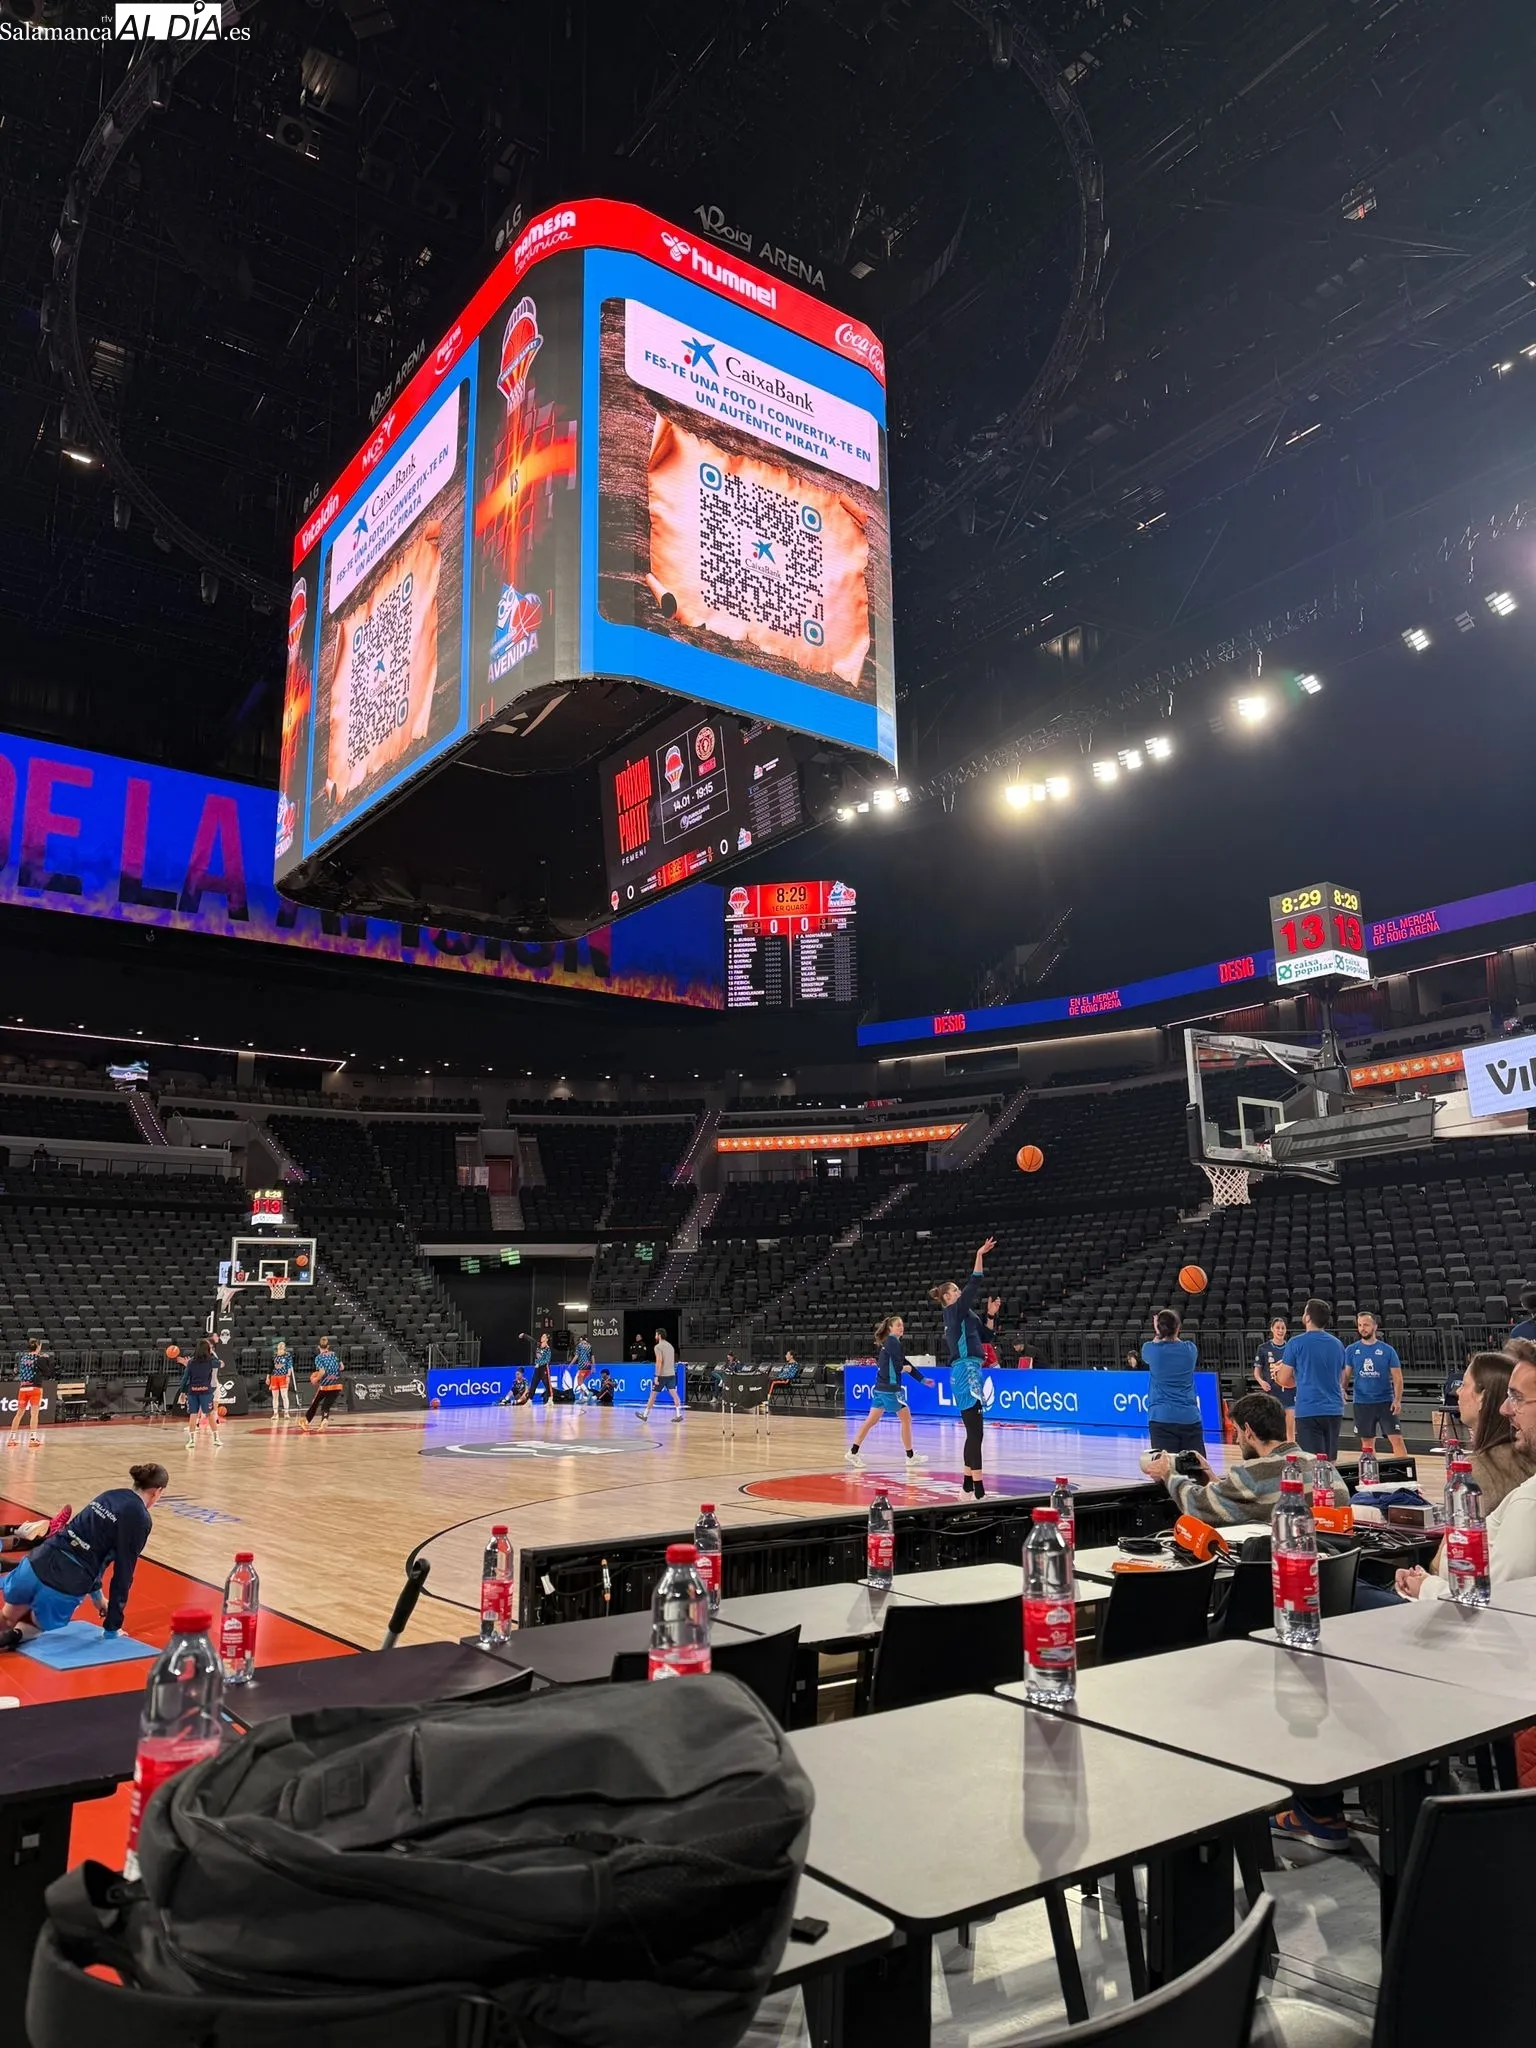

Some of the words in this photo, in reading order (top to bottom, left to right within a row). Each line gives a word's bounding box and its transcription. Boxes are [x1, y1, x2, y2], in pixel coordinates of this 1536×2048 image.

[505, 203, 522, 238] LG
[514, 210, 576, 266] PAMESA
[692, 247, 776, 310] hummel
[759, 242, 826, 291] ARENA
[394, 338, 426, 392] ARENA
[725, 356, 814, 413] CaixaBank
[644, 350, 687, 379] FES-TE
[690, 371, 720, 394] UNA
[723, 387, 756, 410] FOTO
[760, 403, 764, 414] I
[767, 407, 853, 455] CONVERTIX-TE
[855, 447, 871, 463] EN
[695, 390, 716, 409] UN
[719, 403, 782, 439] AUTÈNTIC
[785, 432, 829, 459] PIRATA
[361, 433, 385, 472] MGS
[371, 453, 416, 517] CaixaBank
[336, 559, 354, 585] FES-TE
[354, 542, 368, 564] UNA
[368, 521, 385, 546] FOTO
[389, 459, 438, 521] CONVERTIX-TE
[438, 444, 449, 465] EN
[355, 560, 365, 577] UN
[397, 494, 422, 529] PIRATA
[744, 558, 781, 579] CaixaBank
[487, 632, 539, 684] AVENIDA
[696, 781, 714, 803] 19:15
[0, 755, 94, 896] E
[118, 776, 250, 922] LA
[618, 799, 650, 855] PARTIT
[719, 839, 729, 855] 0
[627, 885, 635, 900] 0
[776, 886, 807, 903] 8:29
[1281, 889, 1322, 914] 8:29
[1333, 889, 1359, 911] 8:29
[785, 904, 808, 912] QUART
[770, 919, 778, 934] 0
[800, 917, 809, 932] 0
[1280, 913, 1326, 955] 13
[1334, 913, 1363, 951] 13
[1373, 924, 1386, 935] EN
[1387, 920, 1399, 932] EL
[1400, 911, 1437, 930] MERCAT
[1373, 934, 1386, 946] DE
[1386, 930, 1408, 944] ROIG
[1409, 921, 1441, 938] ARENA
[1218, 956, 1256, 984] DESIG
[1293, 958, 1319, 970] caixa
[1294, 961, 1334, 978] popular
[1069, 997, 1081, 1008] EN
[1082, 995, 1091, 1006] EL
[1092, 990, 1120, 1004] MERCAT
[1069, 1006, 1080, 1016] DE
[1080, 1003, 1099, 1015] ROIG
[1099, 998, 1122, 1011] ARENA
[933, 1013, 966, 1035] DESIG
[263, 1199, 281, 1214] 13
[592, 1327, 619, 1336] SALIDA
[437, 1379, 500, 1397] endesa
[588, 1377, 625, 1393] ena
[852, 1383, 908, 1400] ena
[999, 1385, 1078, 1412] endesa
